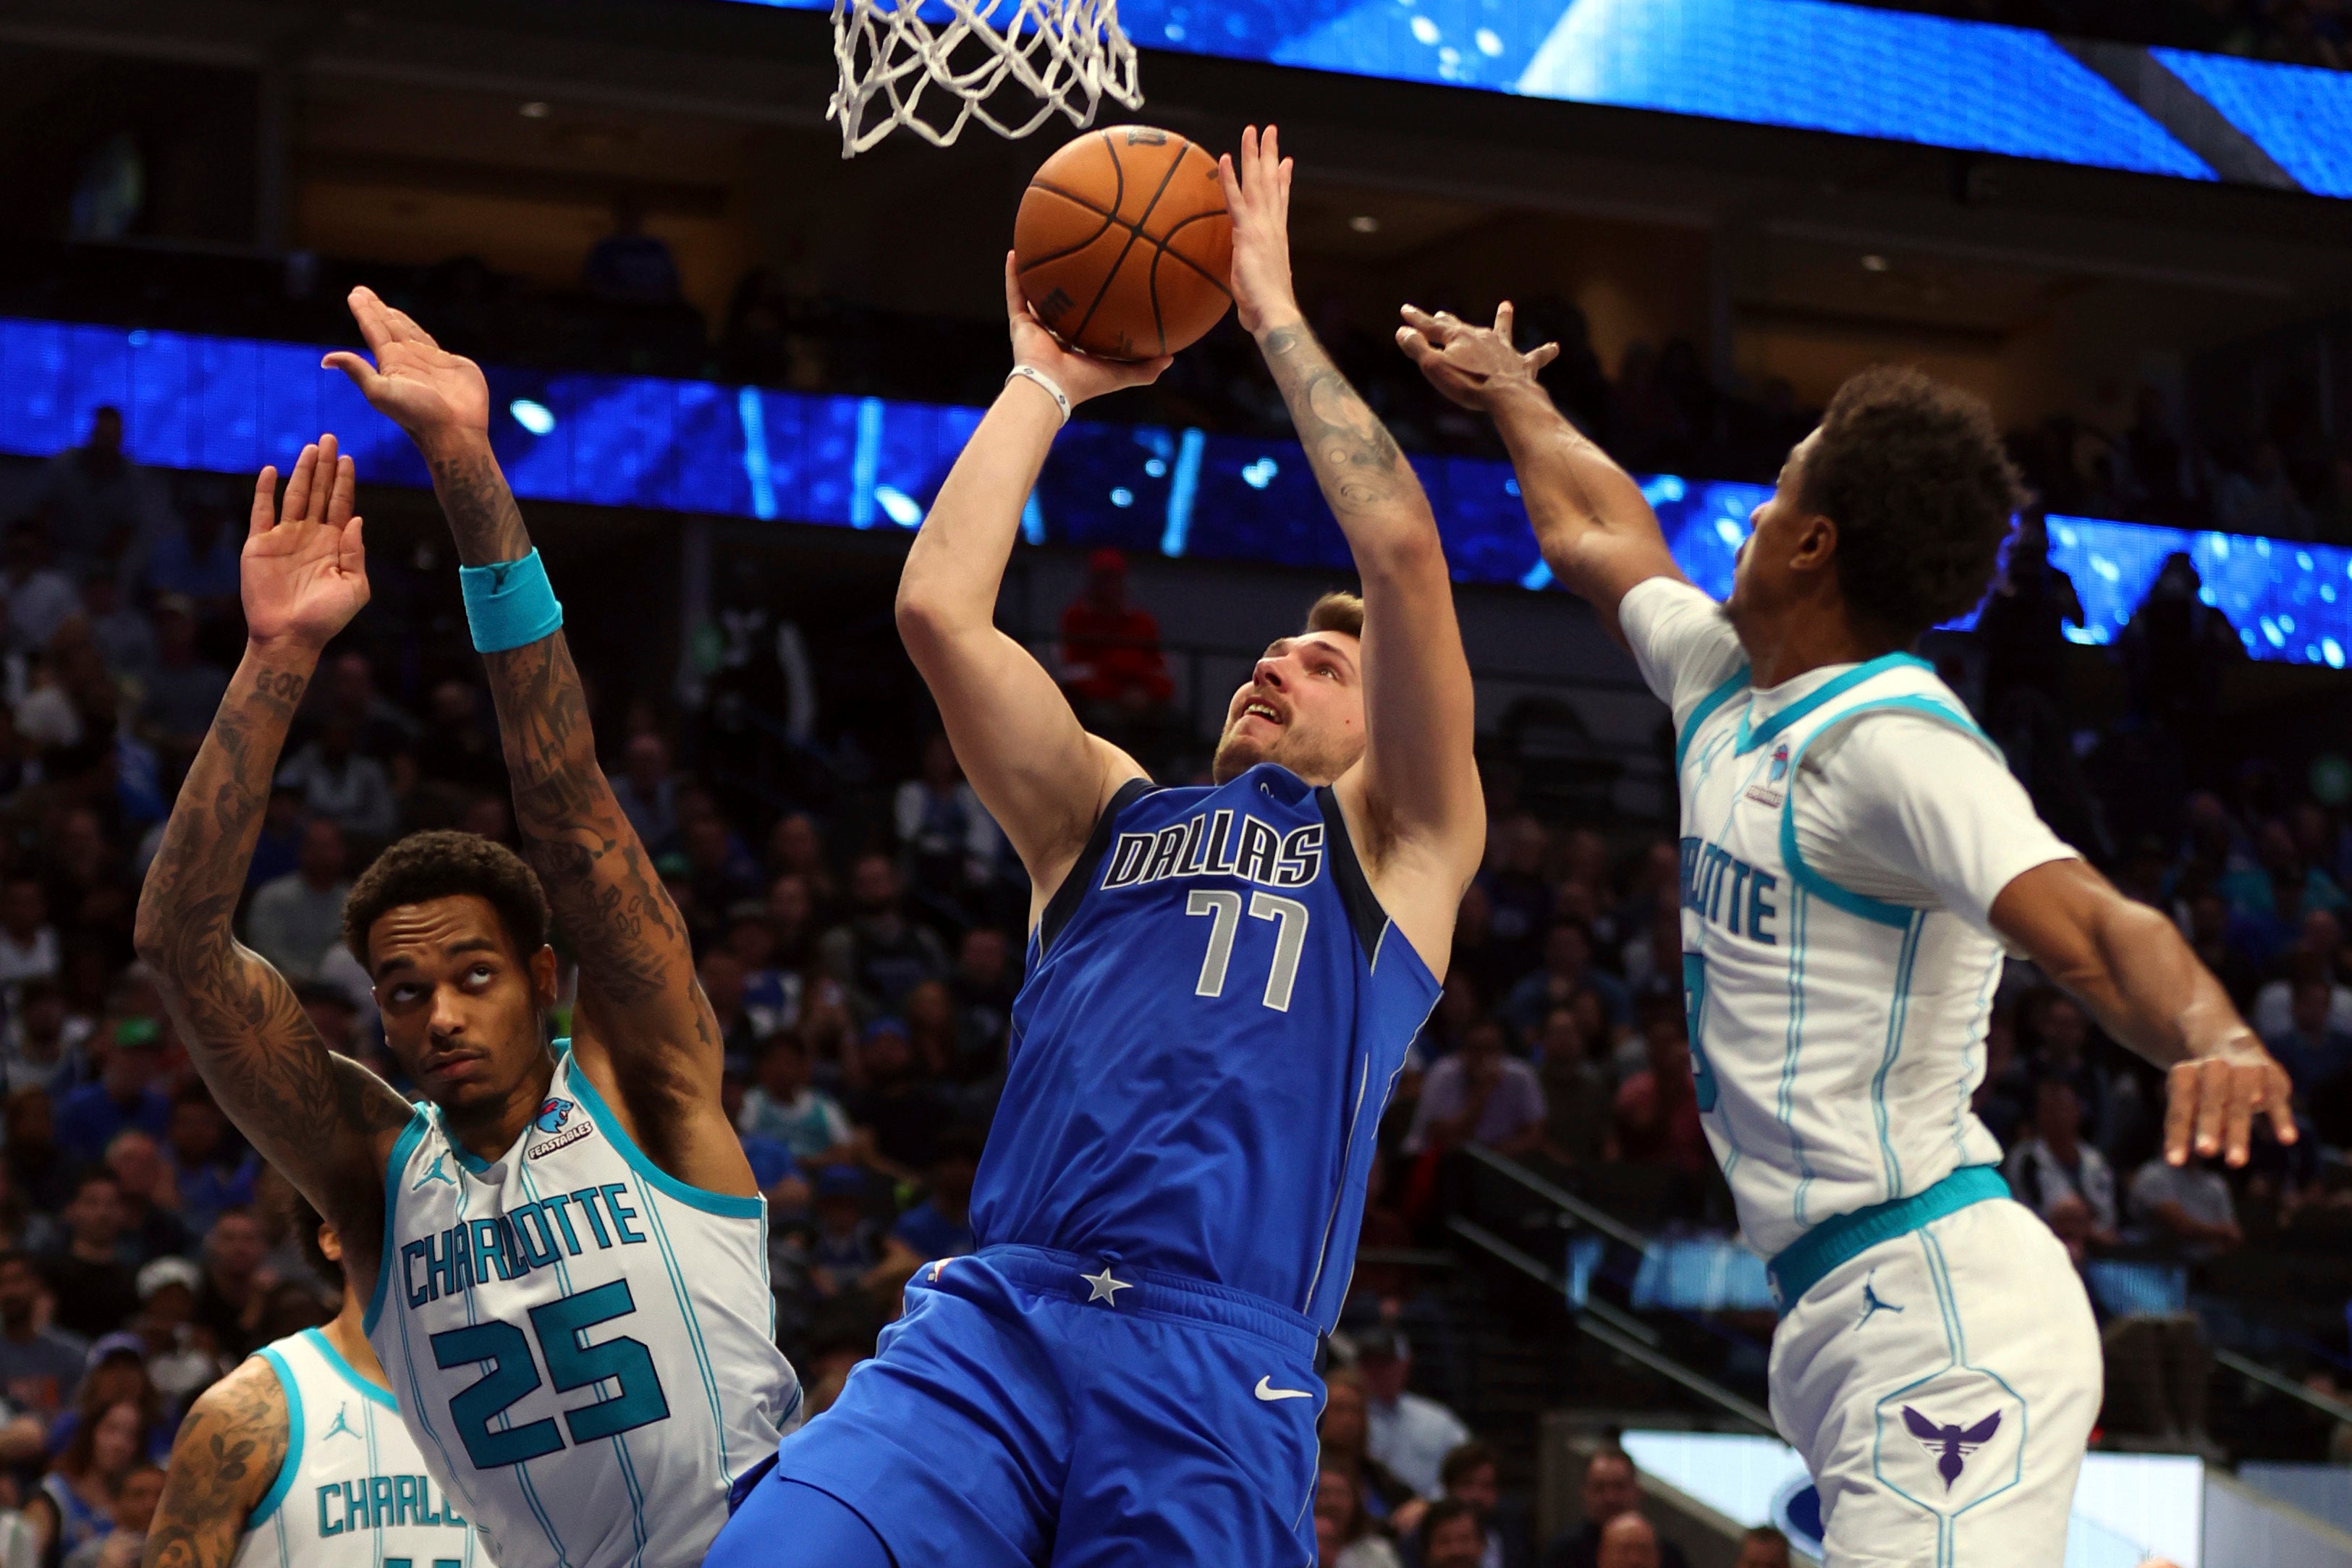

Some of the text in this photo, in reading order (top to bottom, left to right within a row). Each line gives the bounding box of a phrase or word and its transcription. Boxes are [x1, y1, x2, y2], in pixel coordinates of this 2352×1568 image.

[1100, 809, 1325, 890] DALLAS
[1185, 889, 1309, 1012] 77
[529, 1122, 593, 1159] FEASTABLES
[401, 1182, 646, 1309] CHARLOTTE
[428, 1279, 670, 1470] 25
